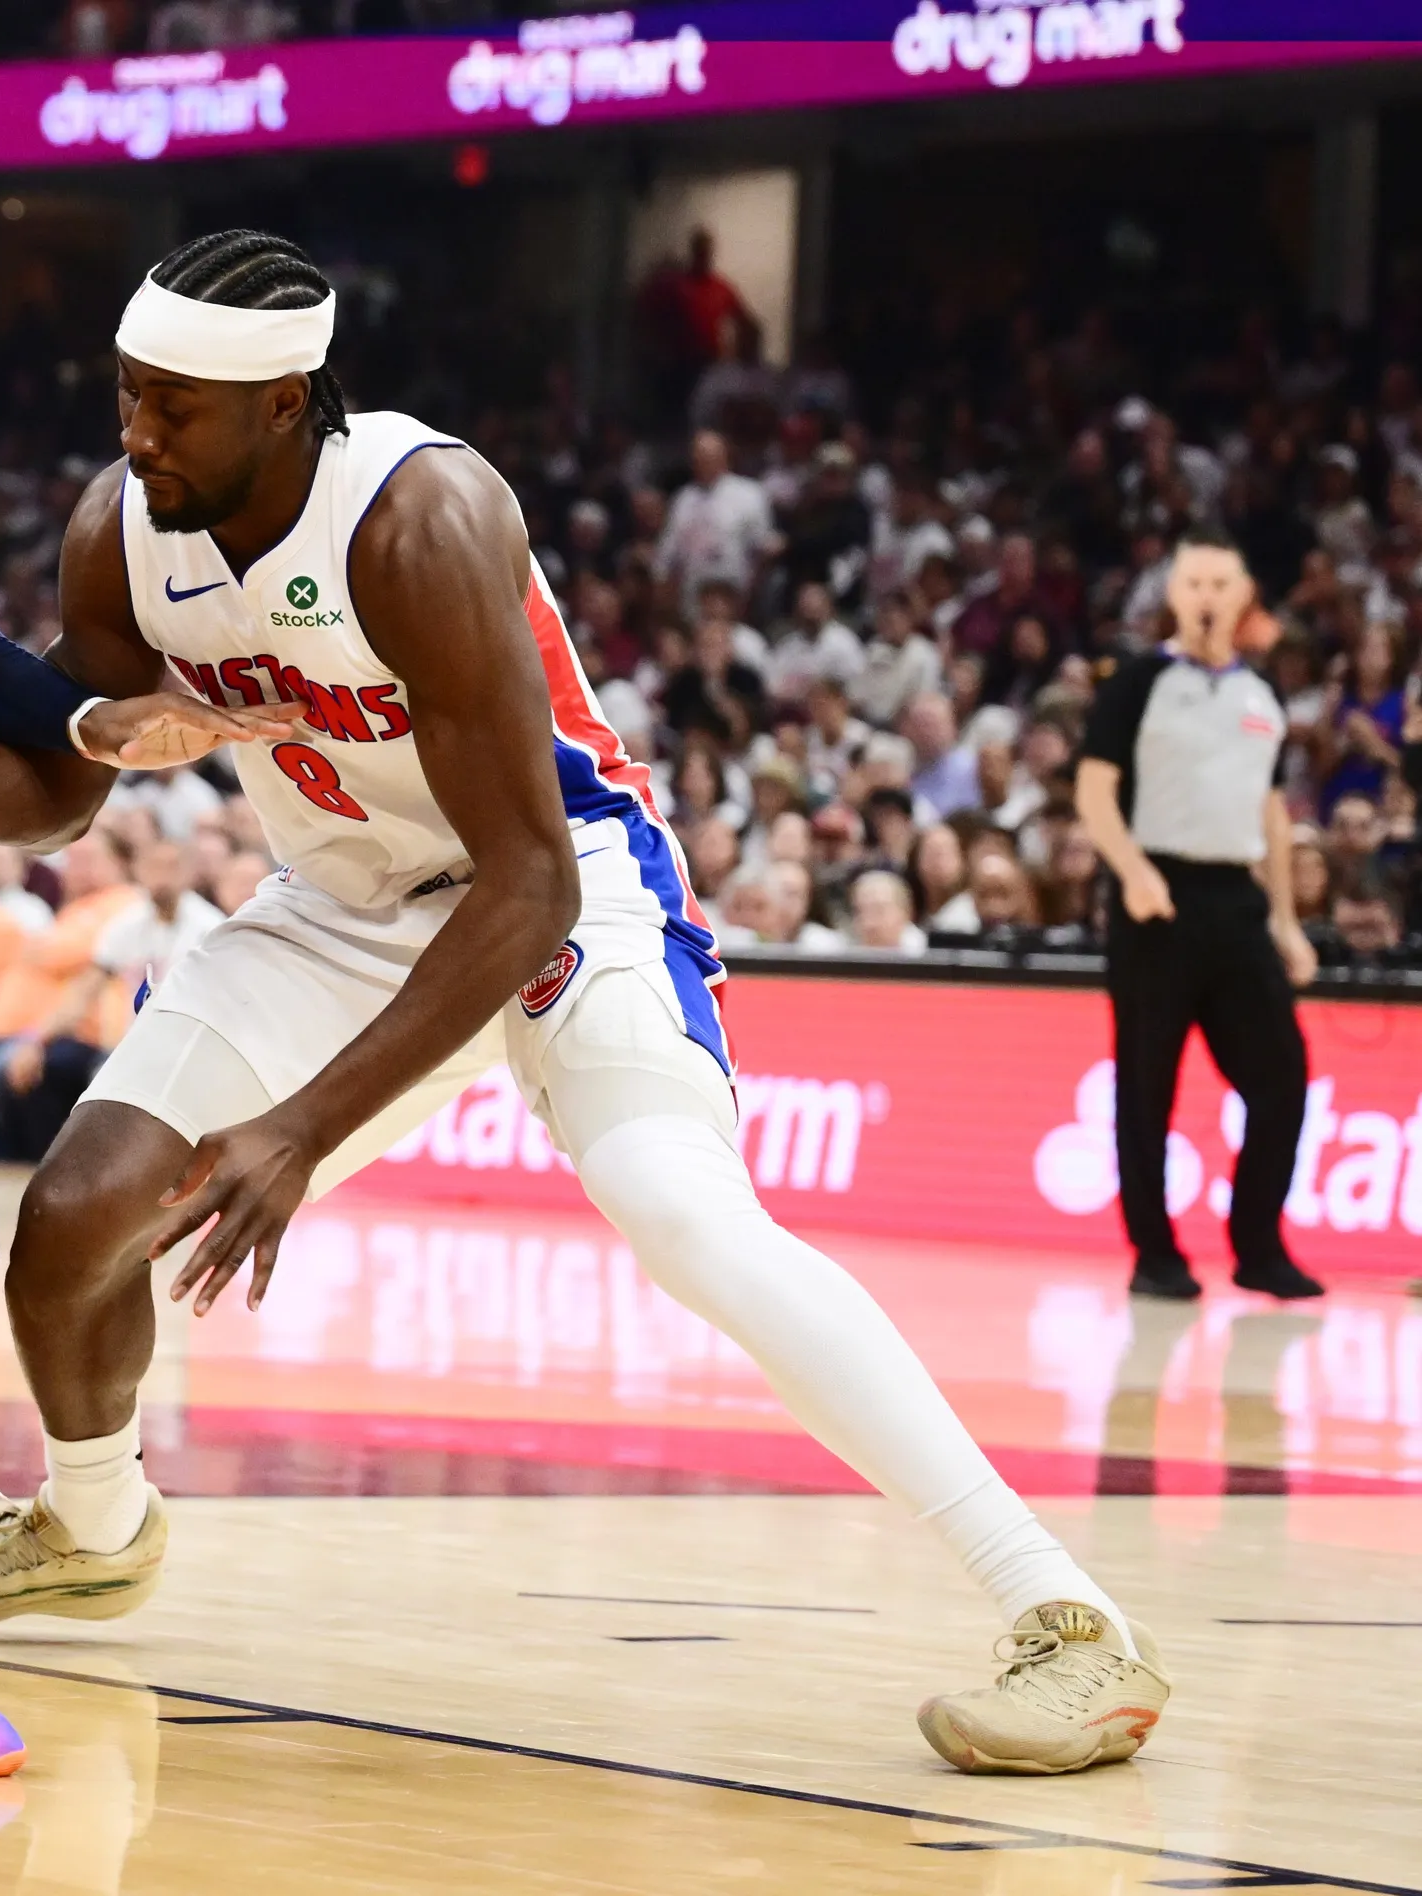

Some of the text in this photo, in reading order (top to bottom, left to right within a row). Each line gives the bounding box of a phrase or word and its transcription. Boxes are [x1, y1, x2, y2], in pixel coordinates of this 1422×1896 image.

[270, 609, 345, 627] StockX
[271, 742, 369, 822] 8
[523, 966, 566, 997] PISTONS
